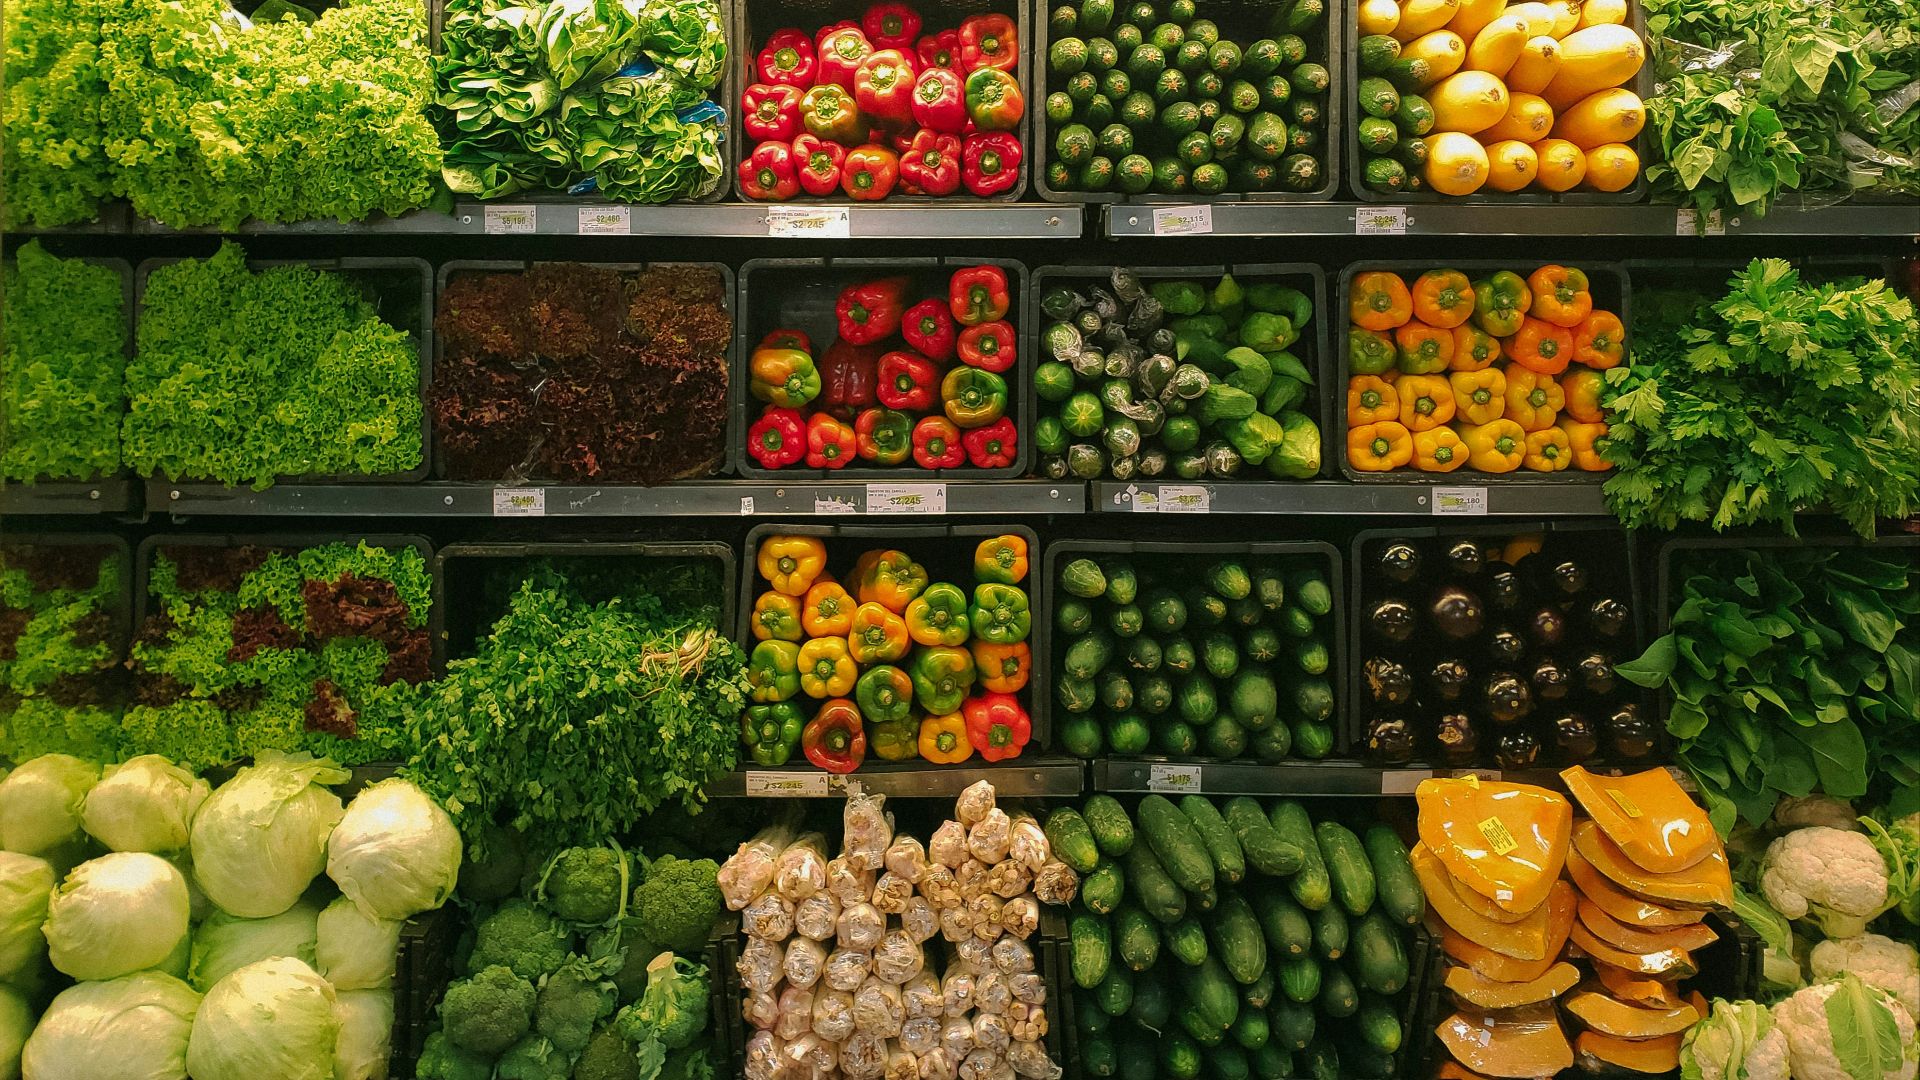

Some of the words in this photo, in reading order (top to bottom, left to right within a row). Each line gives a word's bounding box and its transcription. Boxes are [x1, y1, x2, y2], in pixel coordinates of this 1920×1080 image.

[840, 212, 848, 221] A
[1374, 215, 1398, 224] $2,245
[936, 488, 943, 497] A
[890, 496, 921, 506] $2,245
[1194, 767, 1200, 775] A
[818, 776, 826, 784] A
